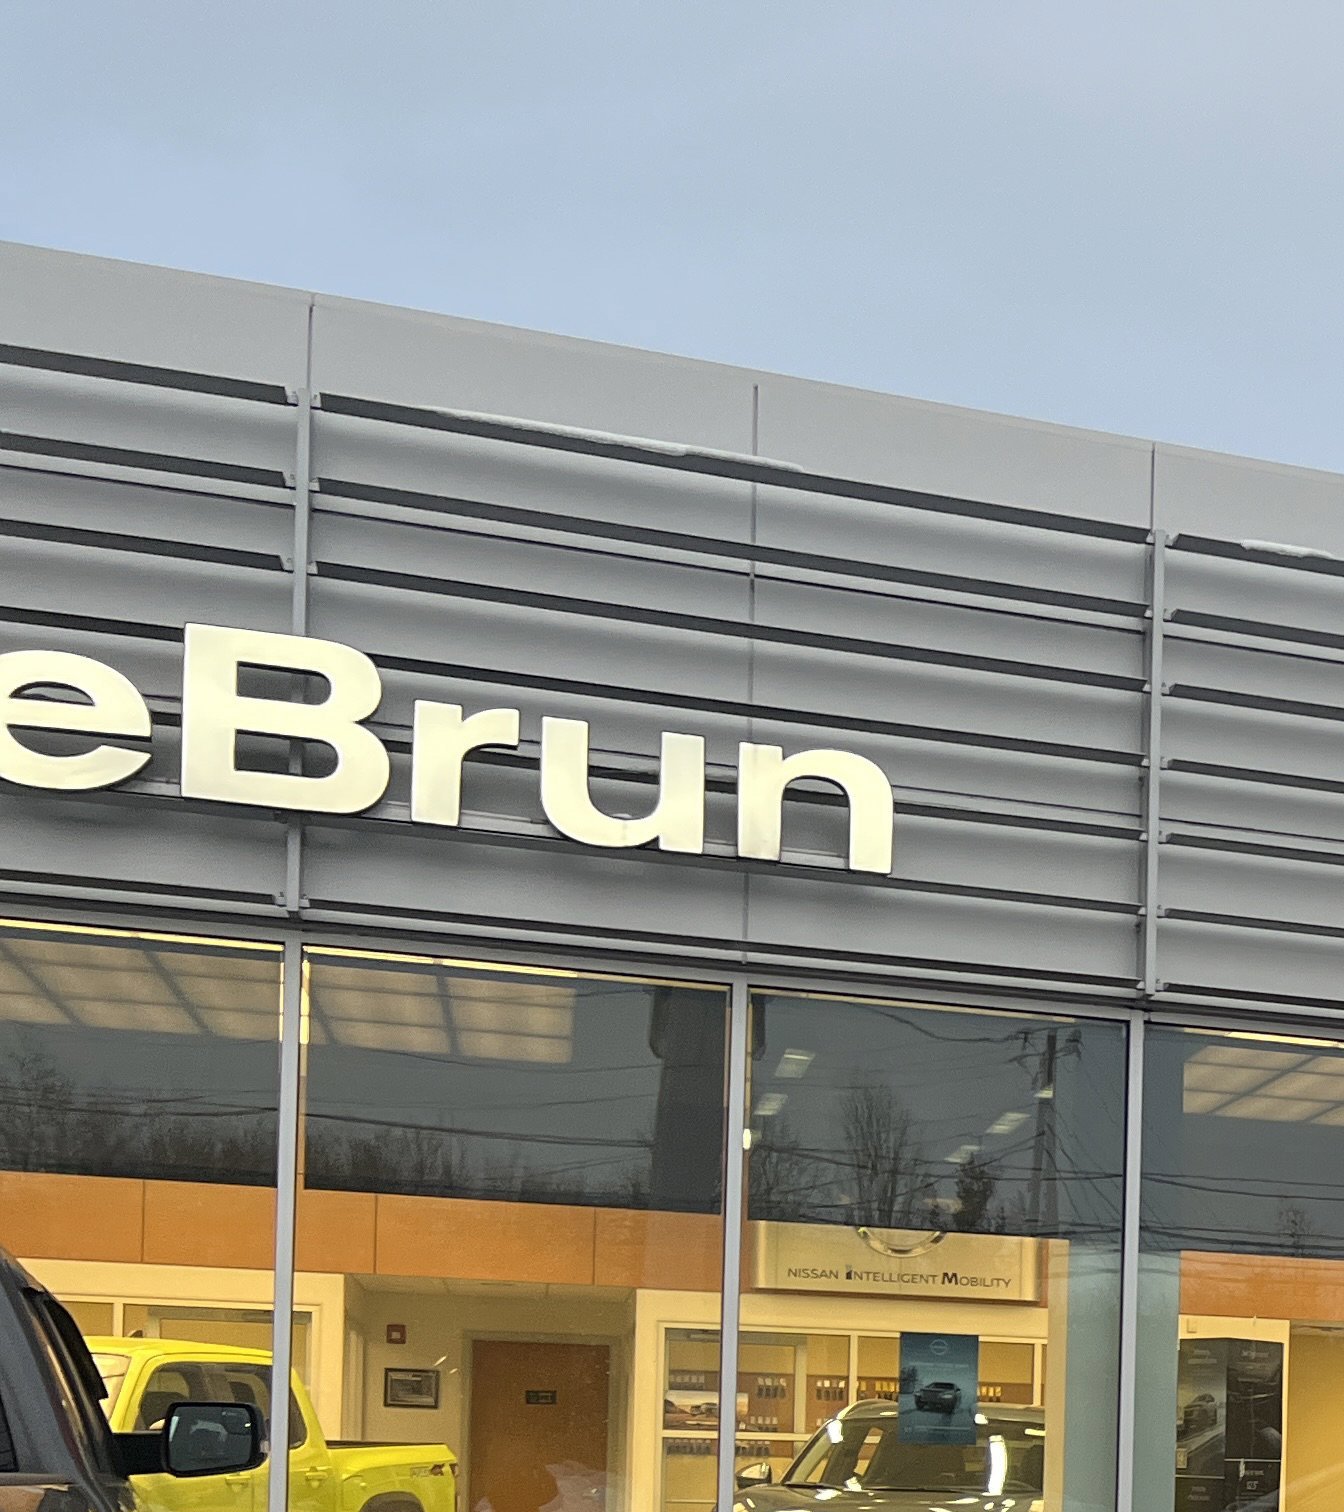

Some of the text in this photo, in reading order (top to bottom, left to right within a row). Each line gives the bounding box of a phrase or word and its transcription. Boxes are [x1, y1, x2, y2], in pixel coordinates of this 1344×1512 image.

[0, 622, 893, 875] eBrun
[787, 1268, 839, 1280] NISSAN
[941, 1272, 1012, 1288] MOBILITY
